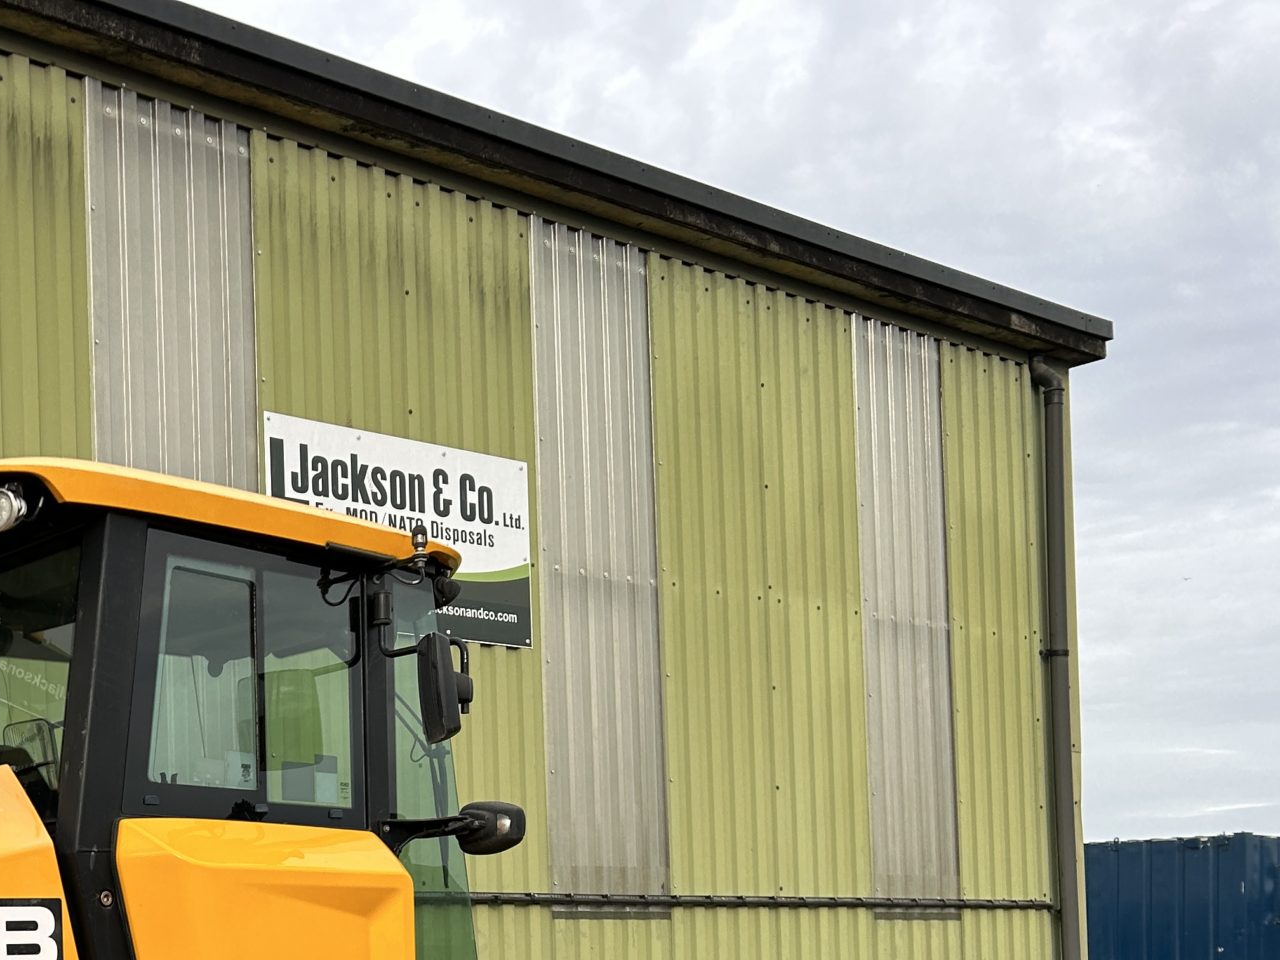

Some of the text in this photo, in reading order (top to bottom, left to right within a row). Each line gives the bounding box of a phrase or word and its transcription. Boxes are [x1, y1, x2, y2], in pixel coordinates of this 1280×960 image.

[432, 468, 453, 518] &
[459, 473, 500, 526] Co.
[503, 512, 525, 531] Ltd.
[430, 520, 495, 548] Disposals
